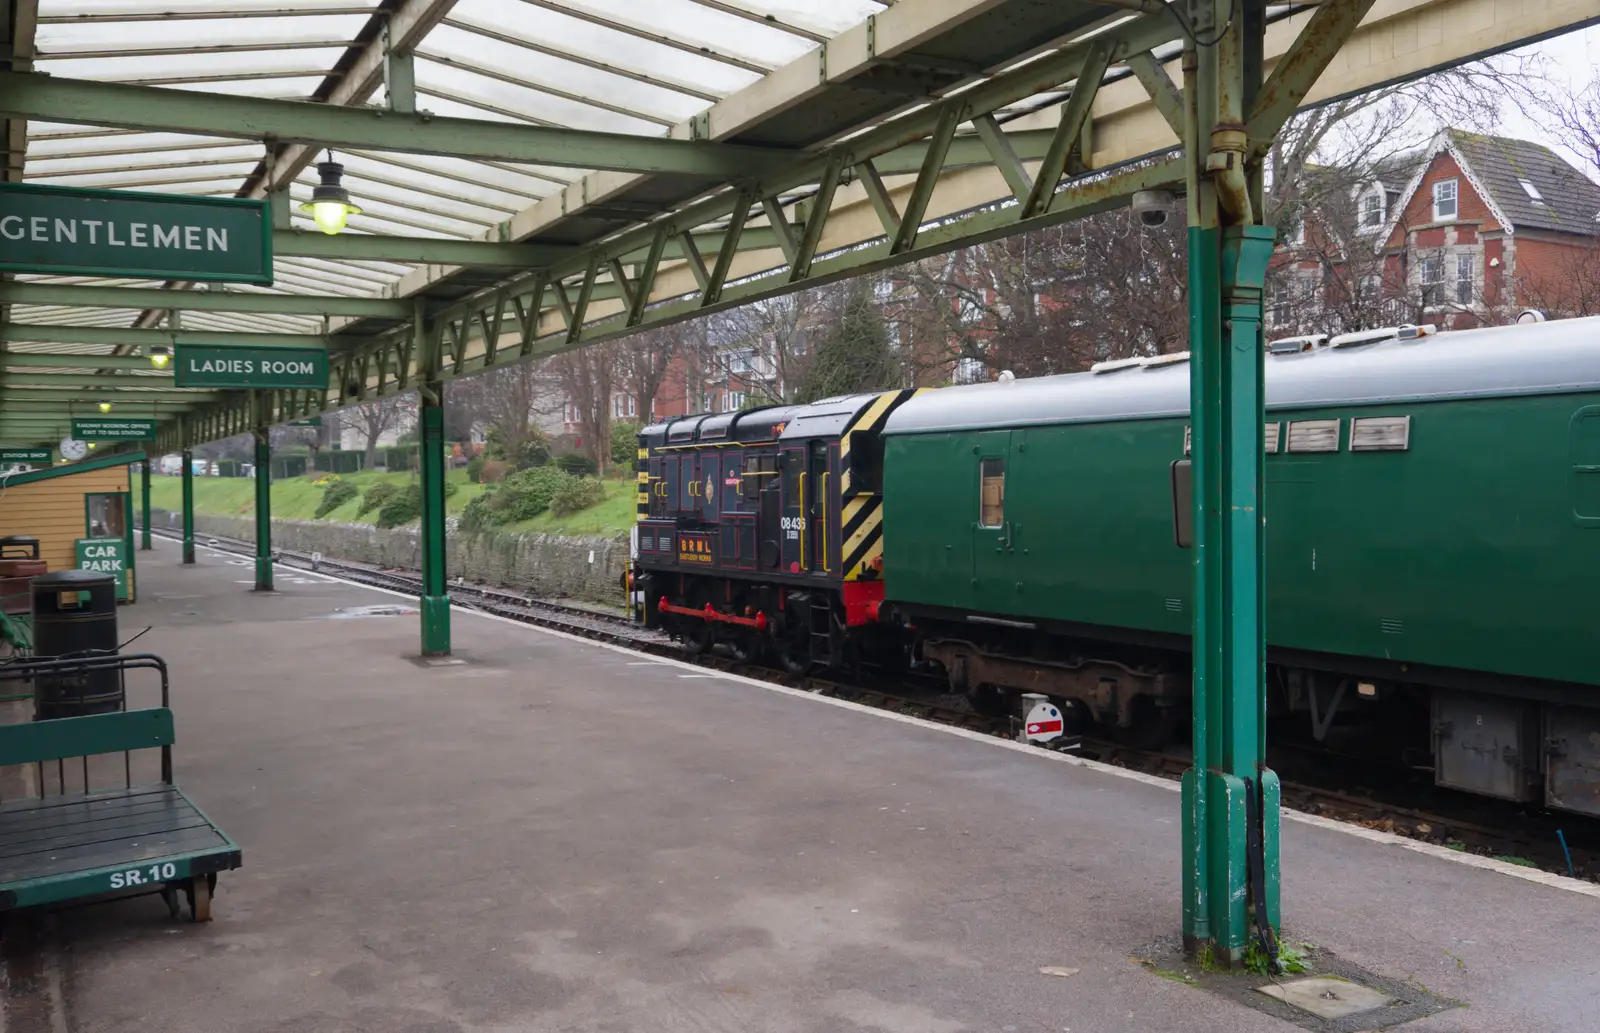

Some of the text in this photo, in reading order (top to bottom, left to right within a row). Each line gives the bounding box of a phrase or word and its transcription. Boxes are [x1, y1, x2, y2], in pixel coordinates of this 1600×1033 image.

[1, 215, 229, 251] GENTLEMEN
[190, 359, 314, 375] LADIES ROOM
[84, 546, 117, 558] CAR
[82, 560, 122, 571] PARK
[110, 862, 176, 889] SR.10
